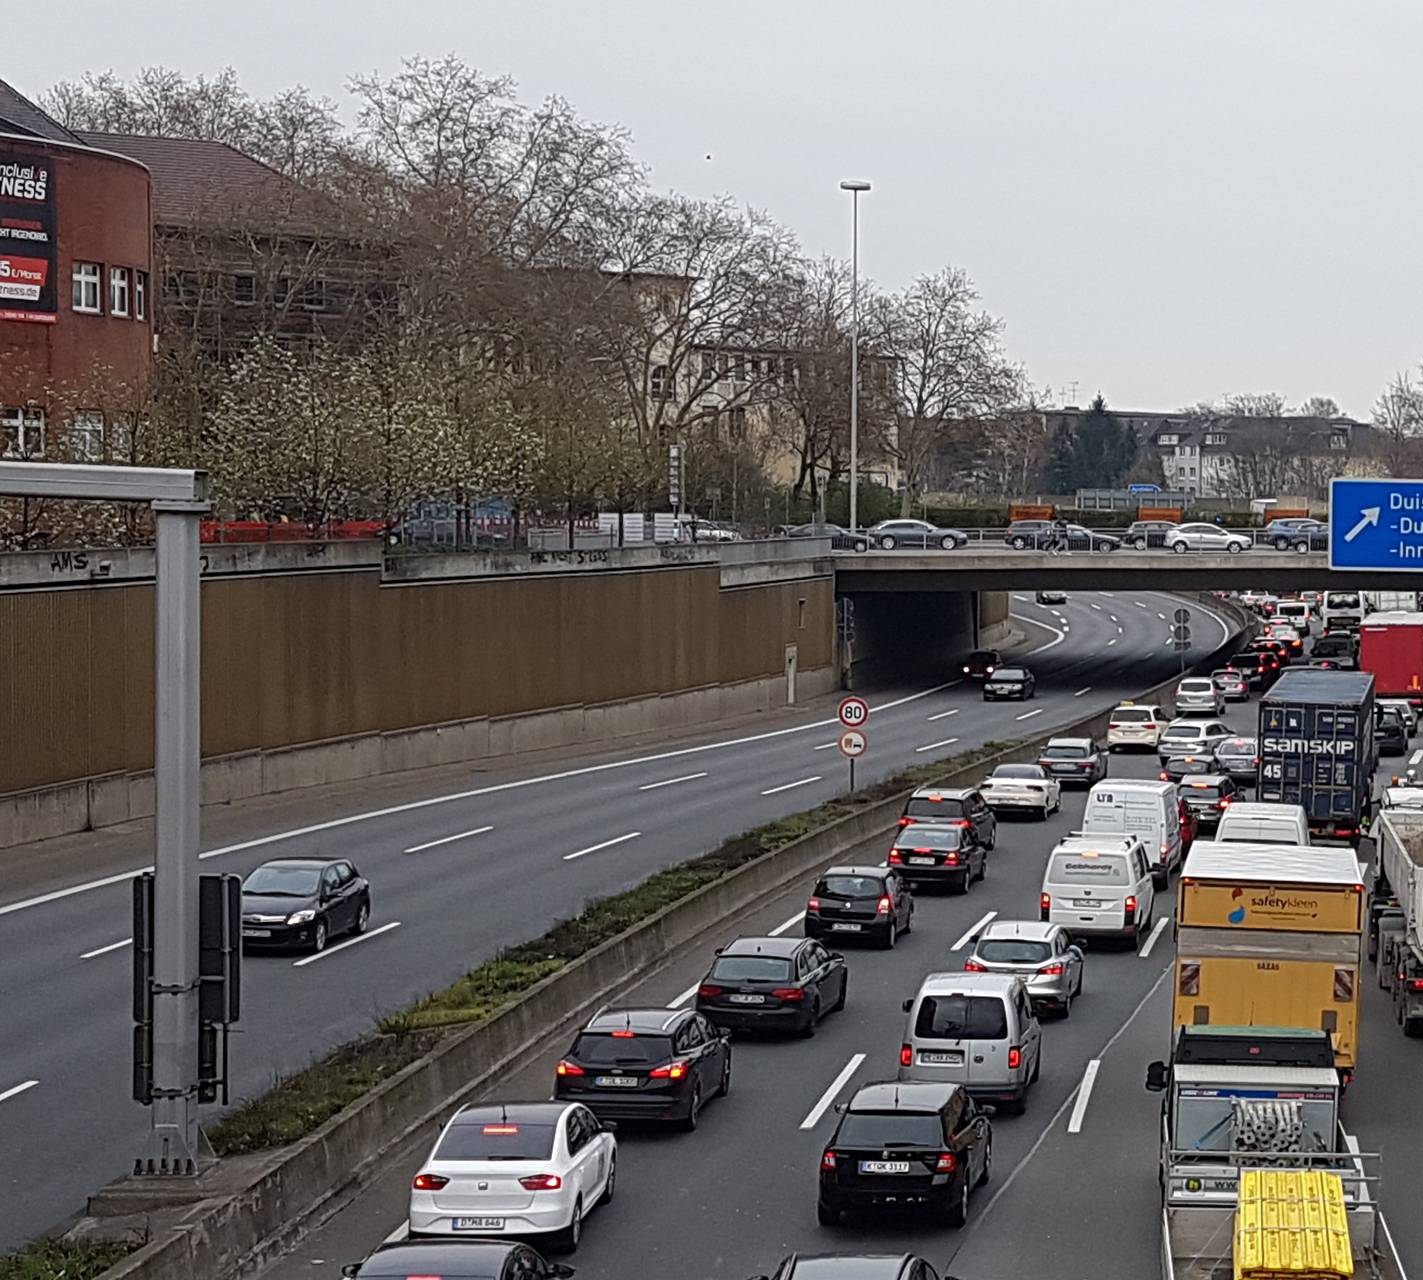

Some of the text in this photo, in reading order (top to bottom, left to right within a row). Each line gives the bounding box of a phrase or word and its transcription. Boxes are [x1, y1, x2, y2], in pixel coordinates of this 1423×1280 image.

[844, 706, 862, 719] 80
[1263, 764, 1281, 778] 45
[1251, 896, 1318, 909] safetykleen
